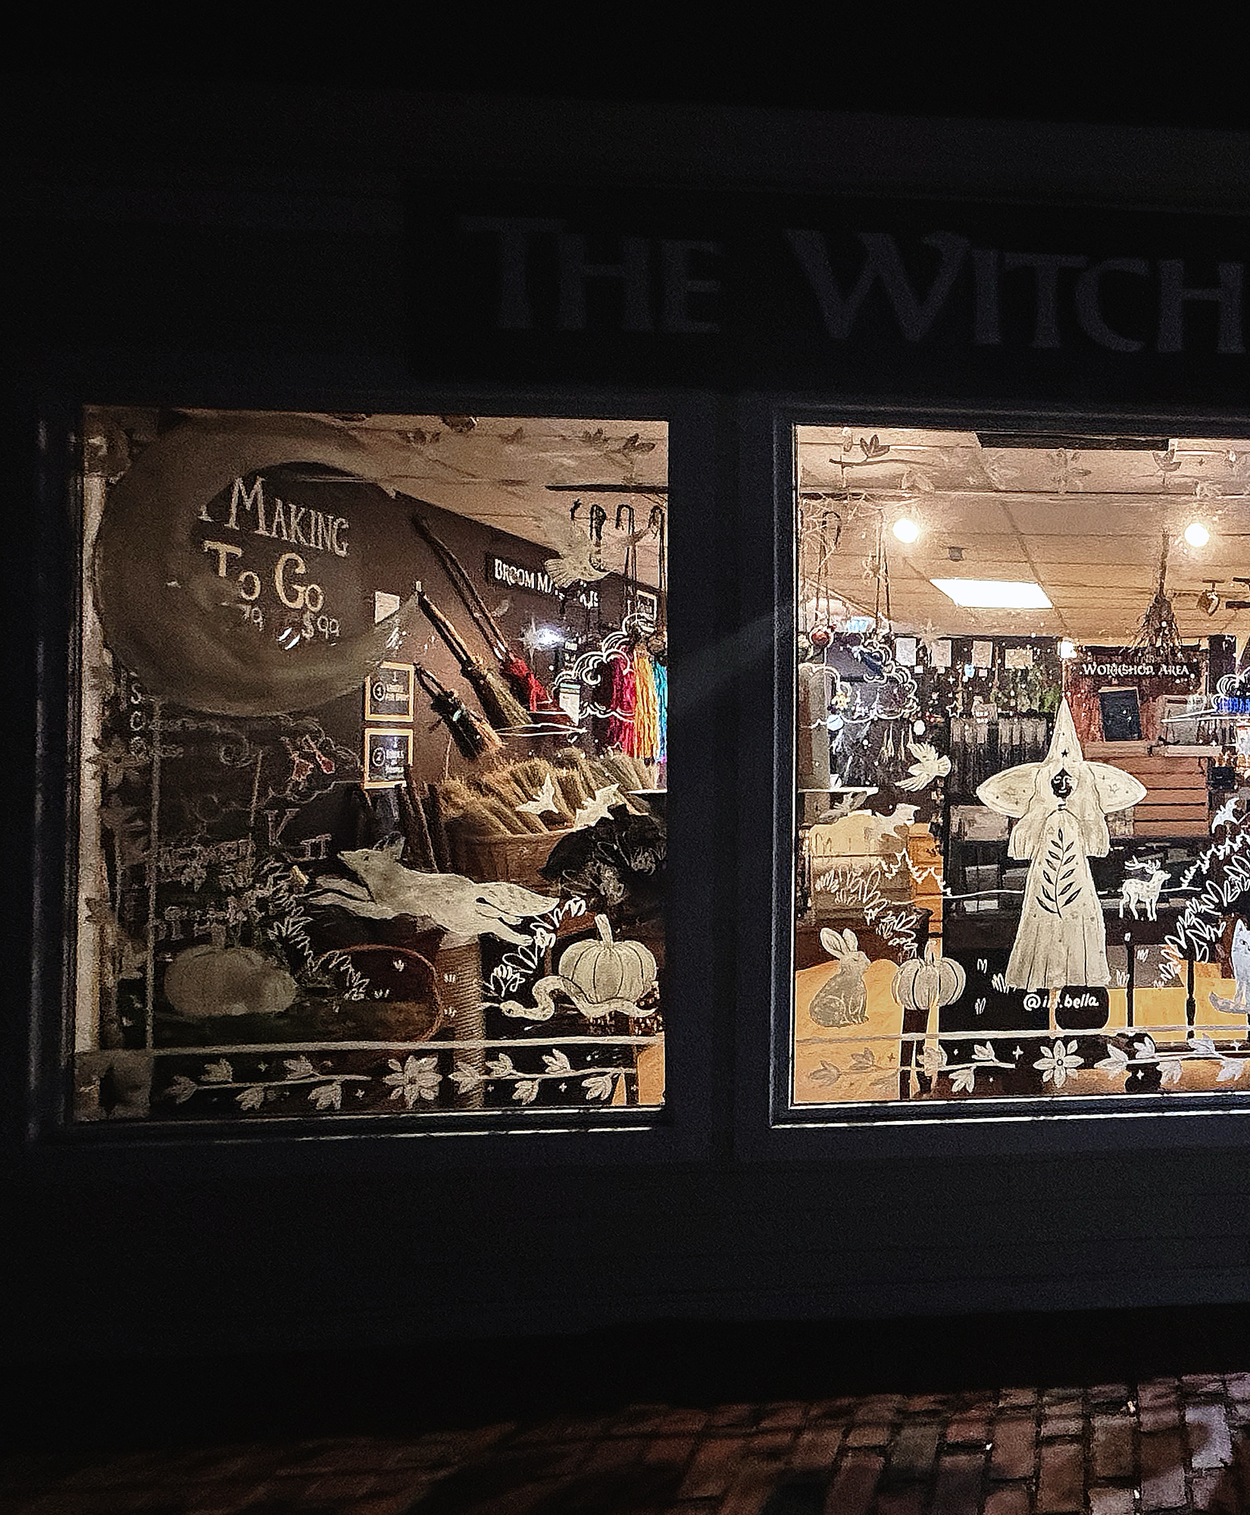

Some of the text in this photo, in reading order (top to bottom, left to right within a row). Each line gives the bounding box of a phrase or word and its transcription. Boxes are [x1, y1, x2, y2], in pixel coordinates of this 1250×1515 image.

[459, 215, 721, 333] THE
[225, 474, 349, 558] MAKING
[202, 540, 324, 613] TO GO
[494, 558, 535, 589] BROOM
[1082, 662, 1190, 677] WORKSHOP AREA
